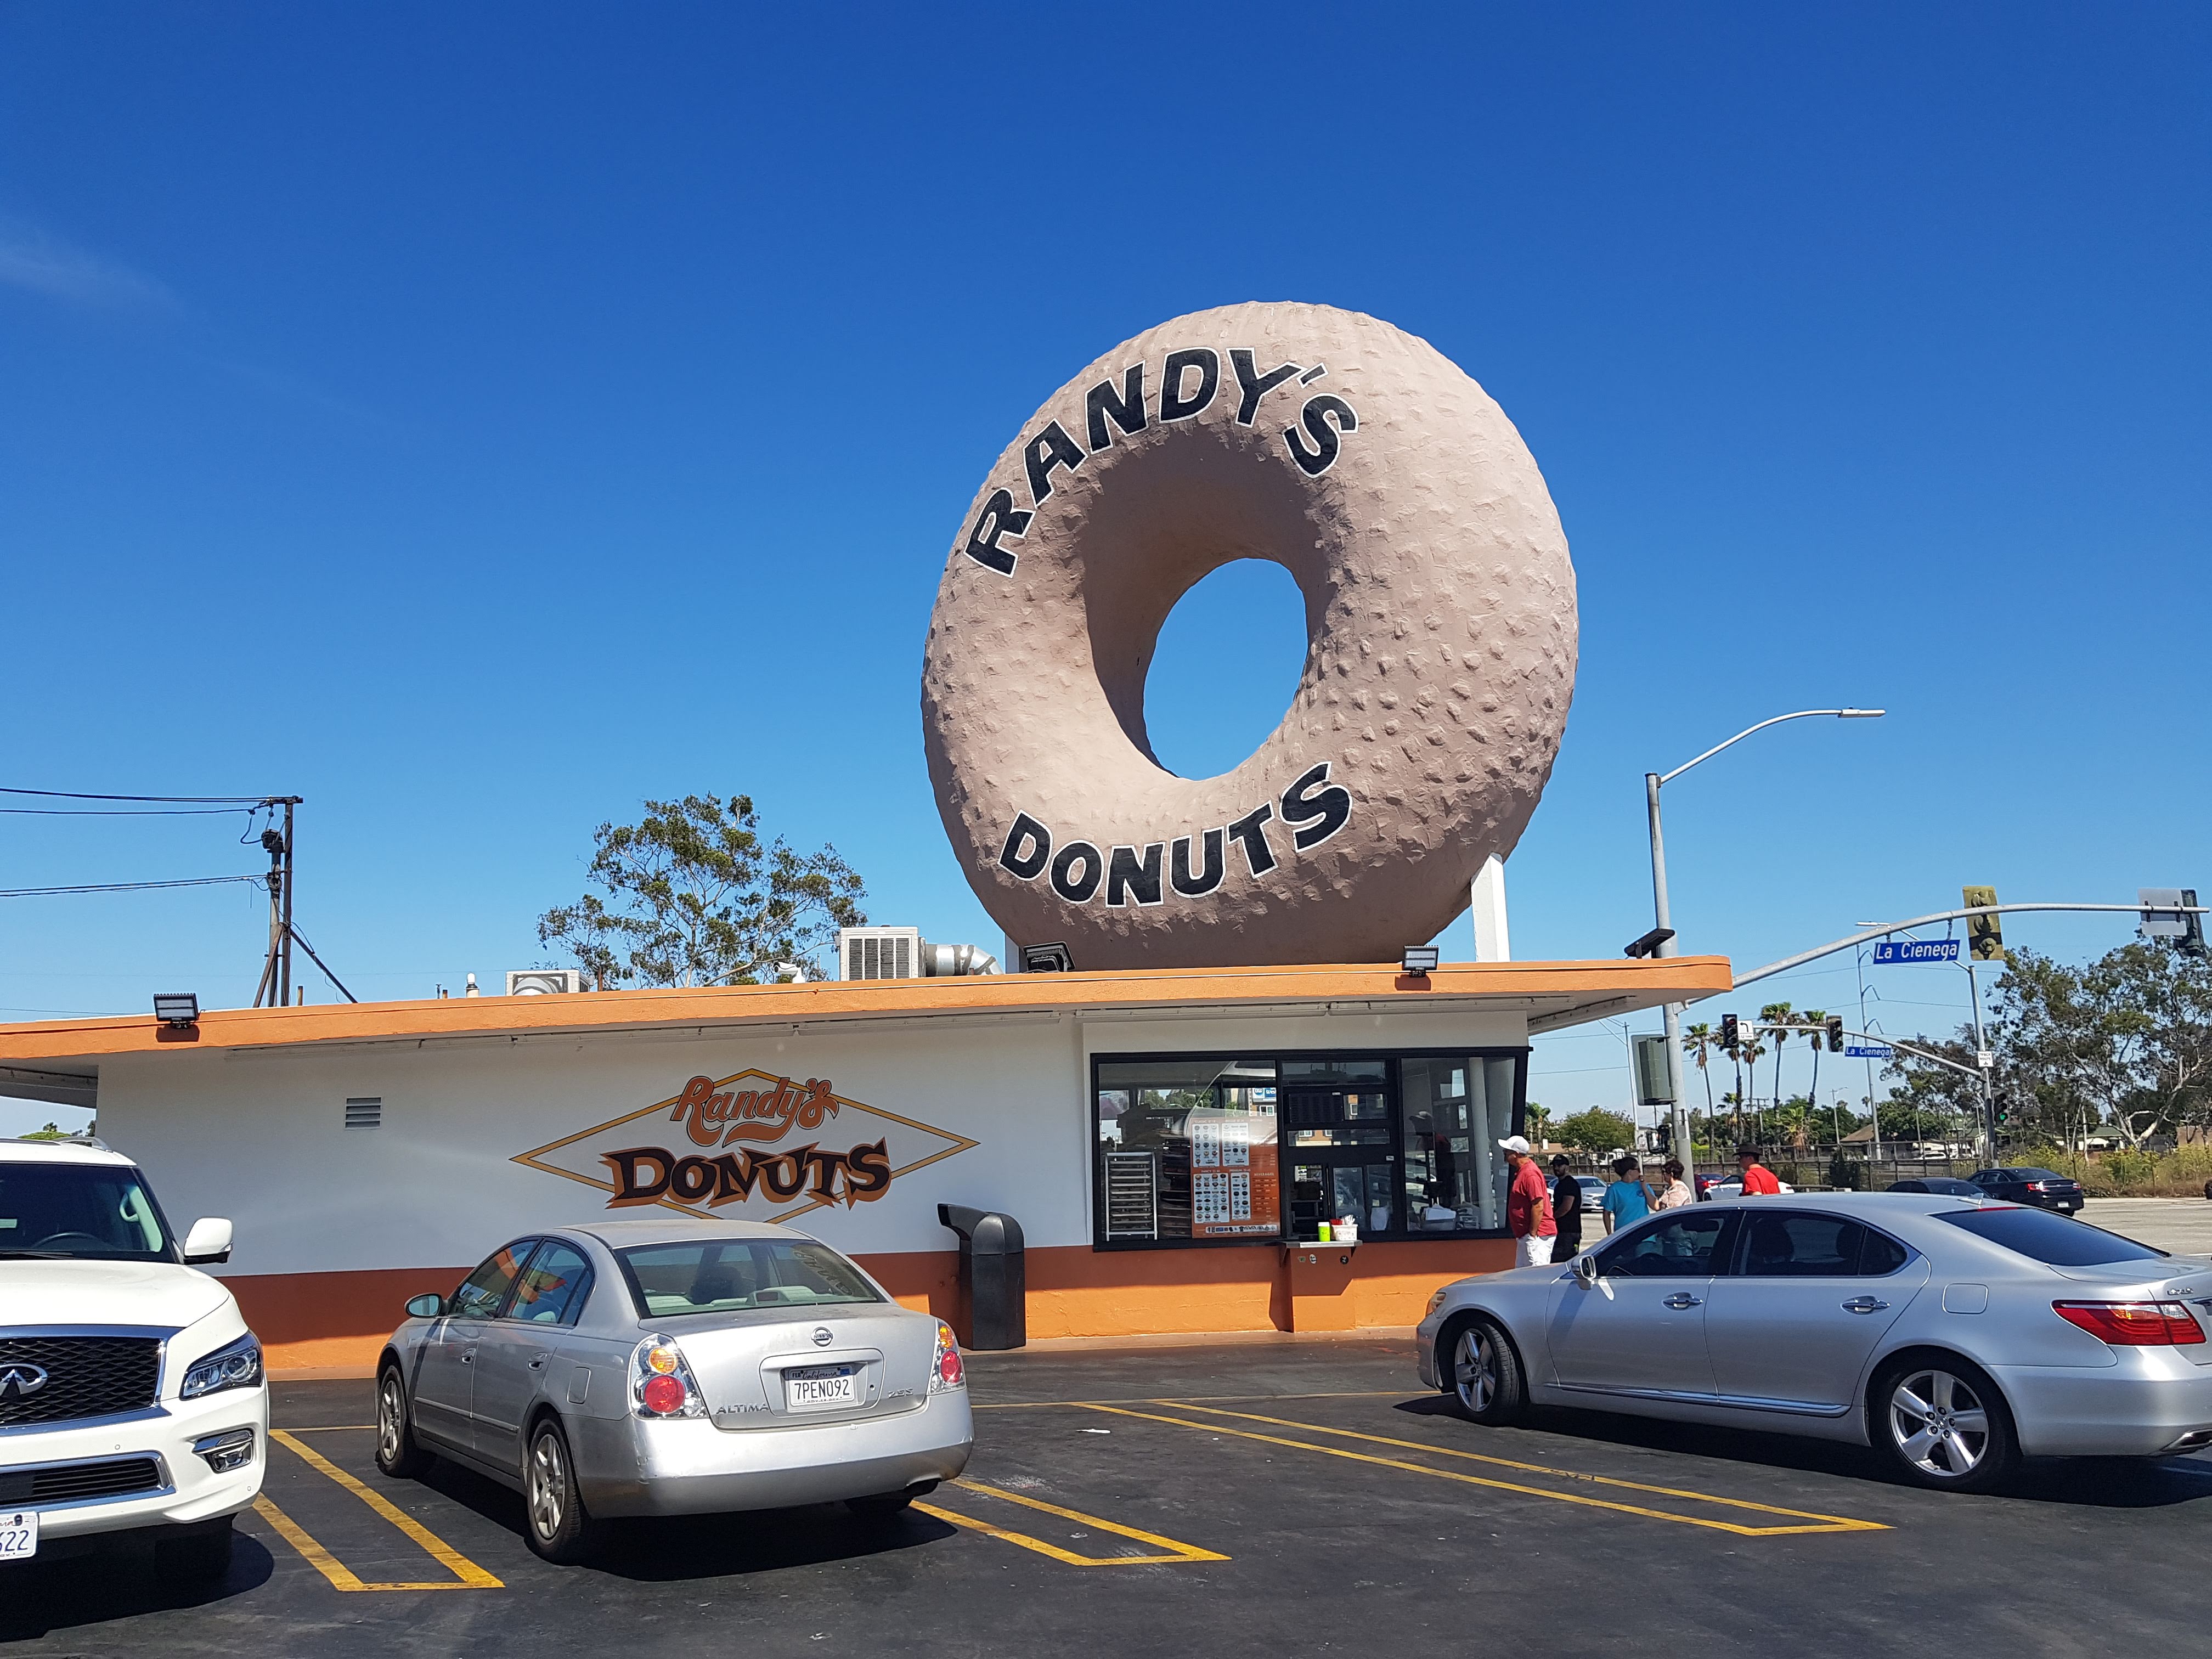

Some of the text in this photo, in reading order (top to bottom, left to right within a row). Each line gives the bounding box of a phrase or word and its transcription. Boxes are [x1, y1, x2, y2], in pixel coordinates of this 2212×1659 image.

[964, 347, 1359, 579] RANDY'S
[998, 761, 1353, 909] DONUTS
[1876, 942, 1957, 961] La Cienega
[1859, 1048, 1890, 1059] Cienega
[669, 1075, 840, 1148] Randy's
[597, 1136, 893, 1211] DONUTS
[802, 1370, 839, 1380] California
[794, 1379, 850, 1400] 7PEN092
[716, 1403, 769, 1414] ALTIMA
